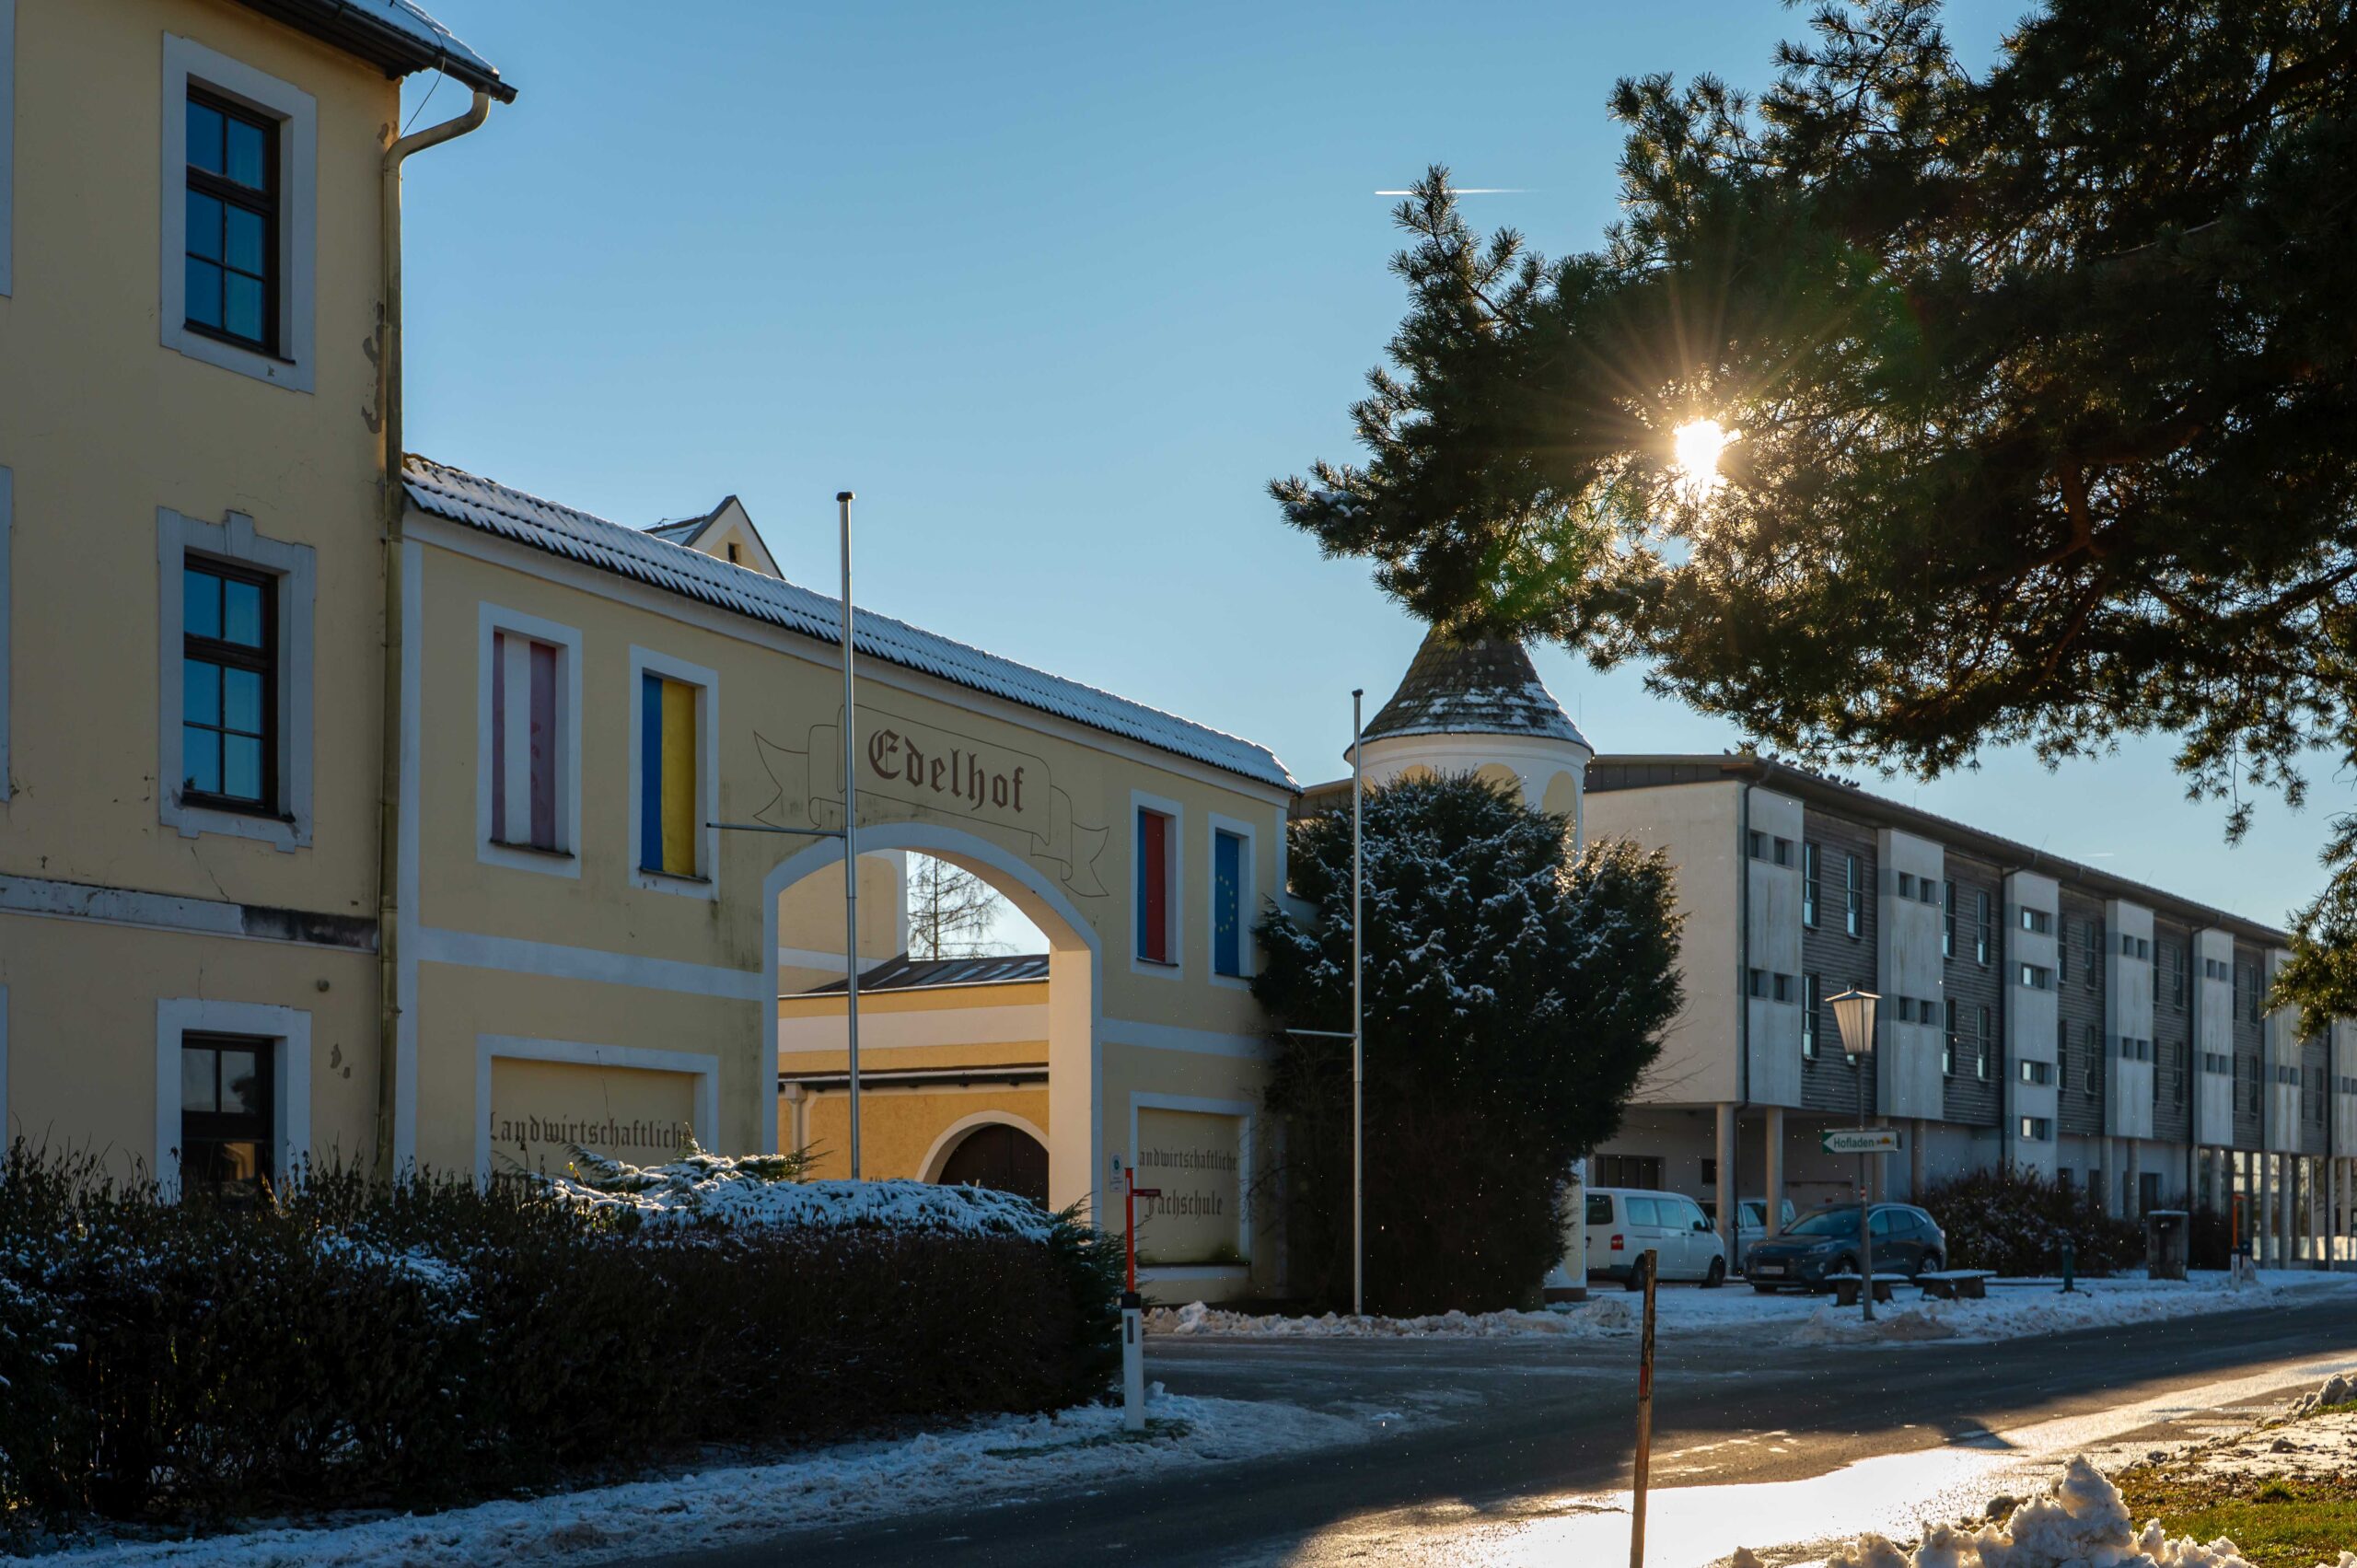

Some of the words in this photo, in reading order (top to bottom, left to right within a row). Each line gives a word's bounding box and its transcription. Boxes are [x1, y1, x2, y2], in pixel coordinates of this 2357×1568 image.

[867, 728, 1024, 813] Edelhof
[1833, 1136, 1875, 1148] Hofladen
[1139, 1148, 1237, 1172] andwirtschaftliche
